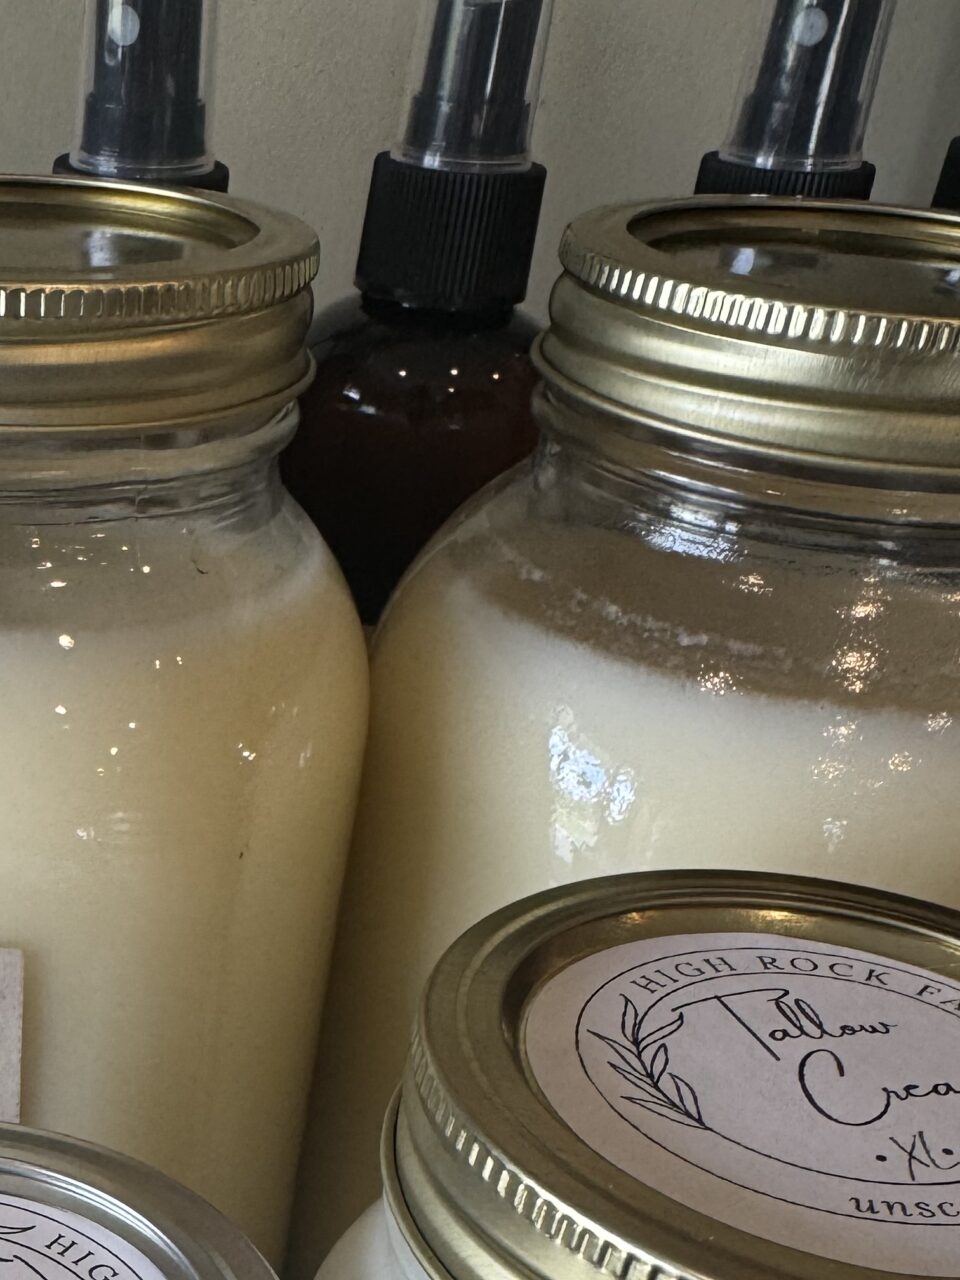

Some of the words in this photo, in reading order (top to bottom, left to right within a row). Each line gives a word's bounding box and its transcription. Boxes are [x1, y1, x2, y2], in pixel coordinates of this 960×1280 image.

[630, 957, 737, 994] HIGH
[757, 955, 890, 986] ROCK
[671, 988, 898, 1061] Tallow
